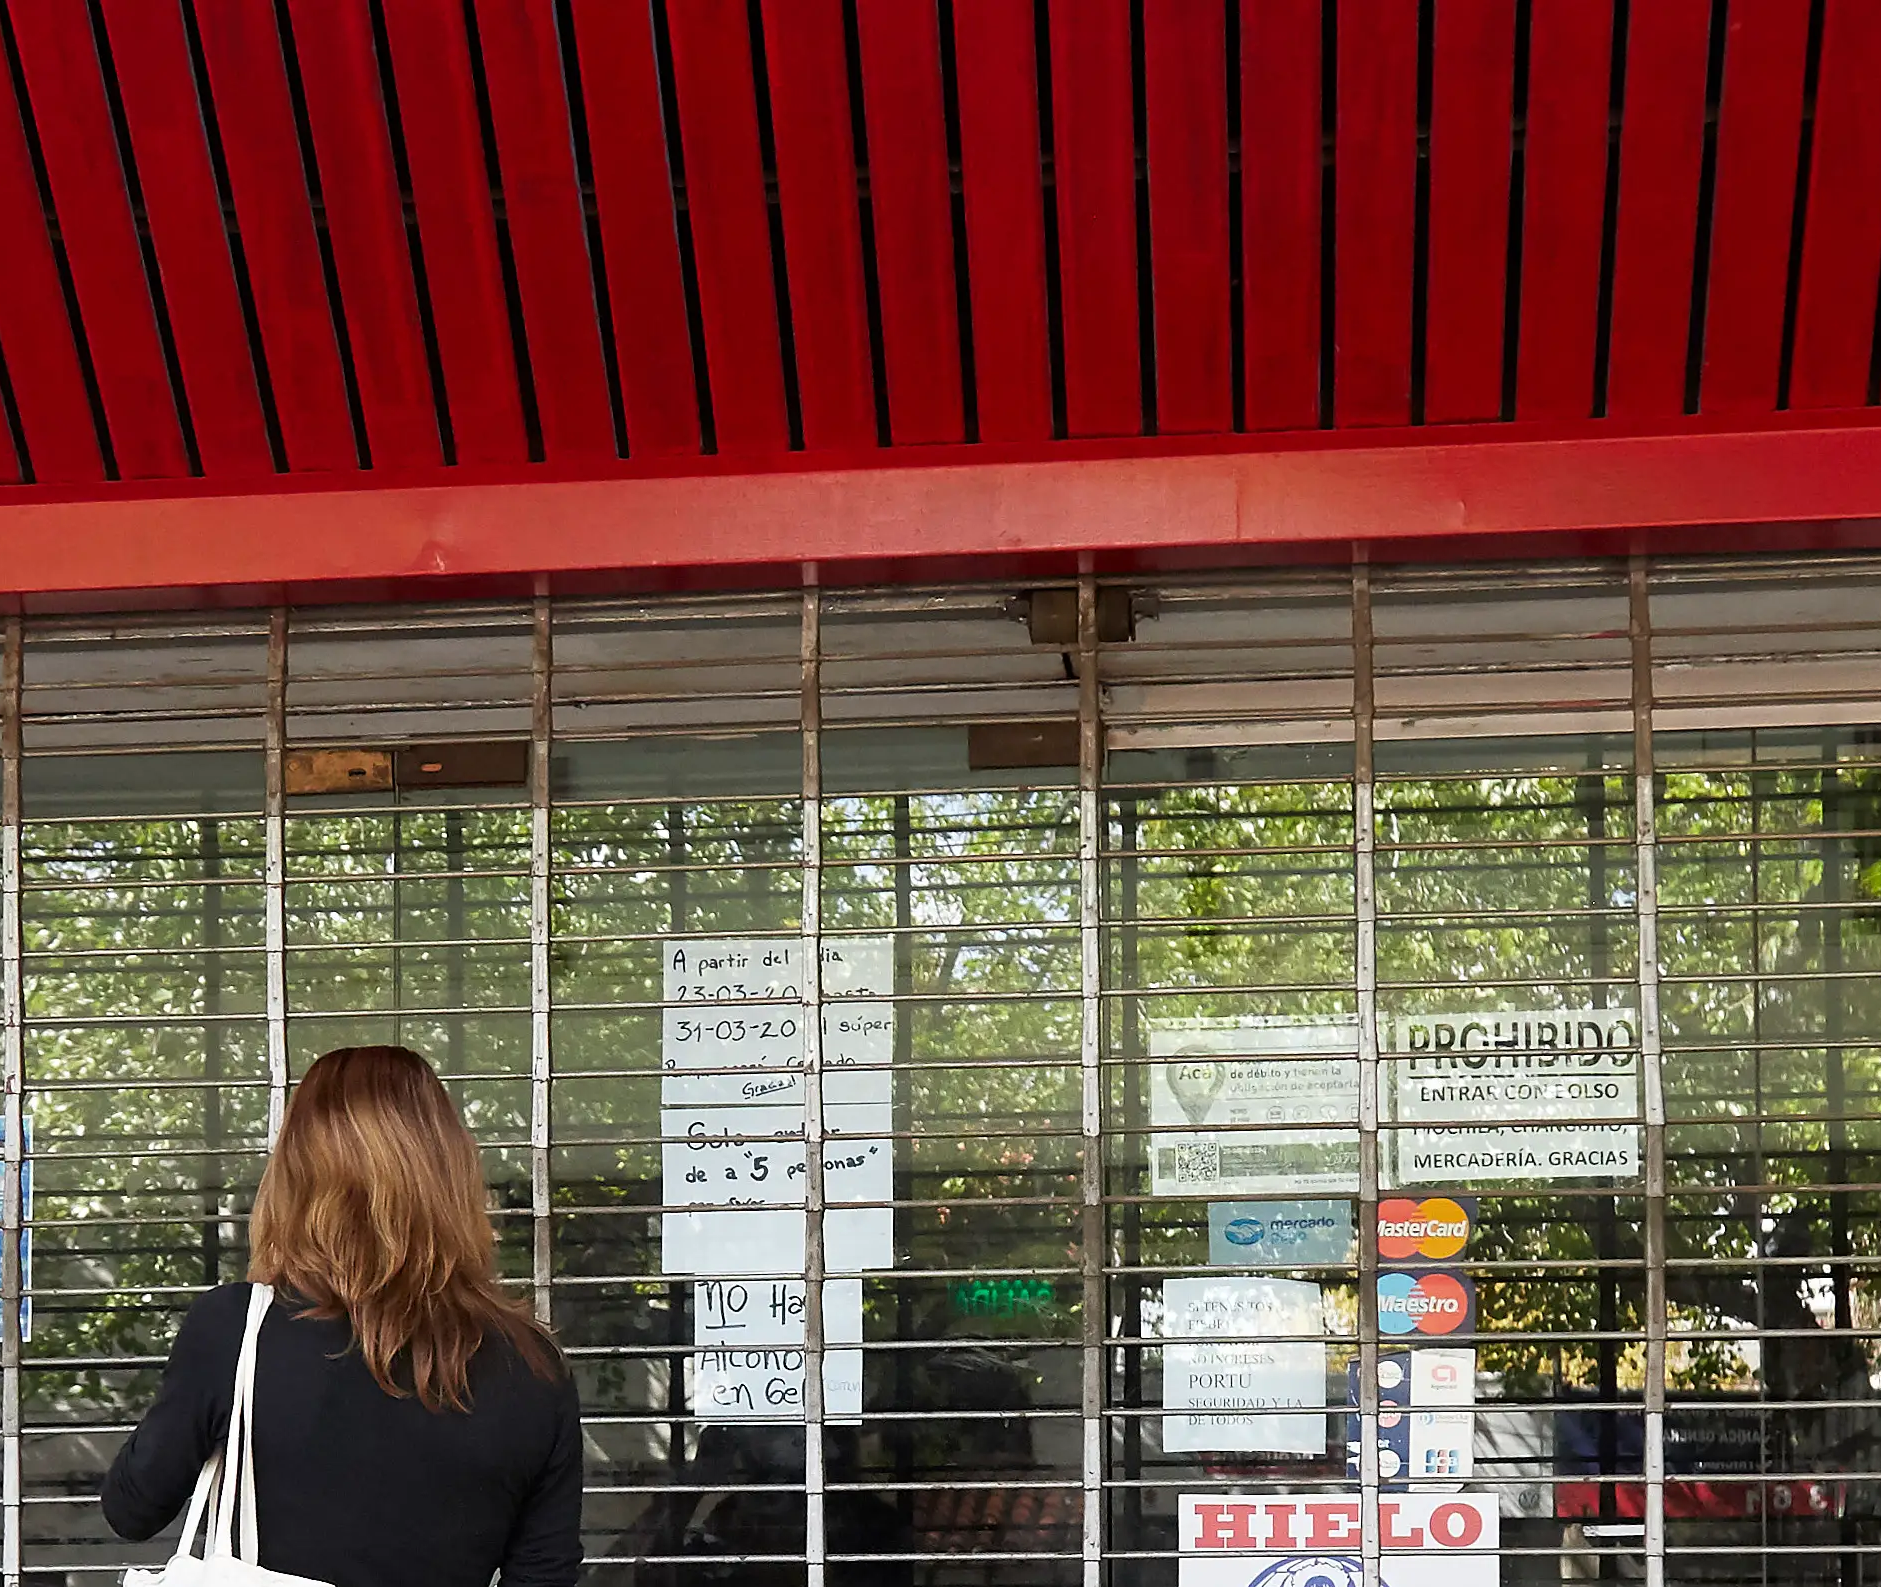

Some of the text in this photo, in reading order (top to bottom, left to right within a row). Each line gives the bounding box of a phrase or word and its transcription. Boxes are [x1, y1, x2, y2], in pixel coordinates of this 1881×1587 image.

[672, 948, 790, 977] A partir del
[675, 1015, 892, 1043] 31-03-20 súper
[1408, 1020, 1635, 1070] PROHIBIDO
[685, 1165, 708, 1184] de
[725, 1166, 738, 1181] a
[786, 1145, 880, 1180] peonas"
[1548, 1150, 1628, 1166] GRACIAS
[1379, 1295, 1460, 1314] Maestro
[712, 1384, 755, 1411] en
[1193, 1502, 1483, 1549] HIELO
